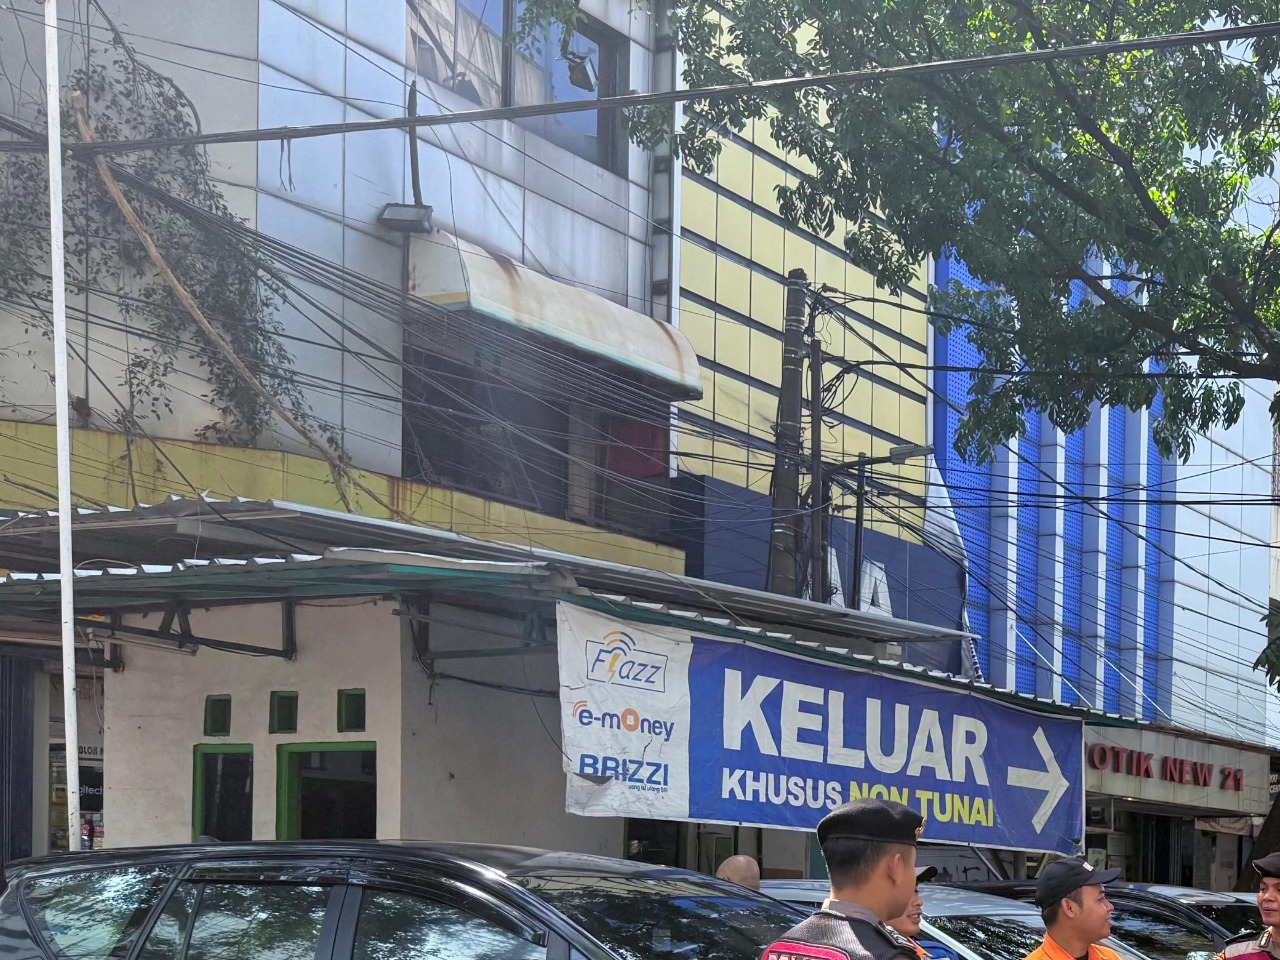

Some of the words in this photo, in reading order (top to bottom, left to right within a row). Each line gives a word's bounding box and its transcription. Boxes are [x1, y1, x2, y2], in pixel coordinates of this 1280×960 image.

[591, 648, 662, 684] Flazz
[723, 668, 989, 786] KELUAR
[579, 754, 669, 786] BRIZZI
[1085, 741, 1154, 779] OTIK
[1162, 755, 1214, 787] NEW
[1220, 767, 1244, 791] 21
[722, 767, 842, 809] KHUSUS
[915, 790, 994, 827] TUNAI
